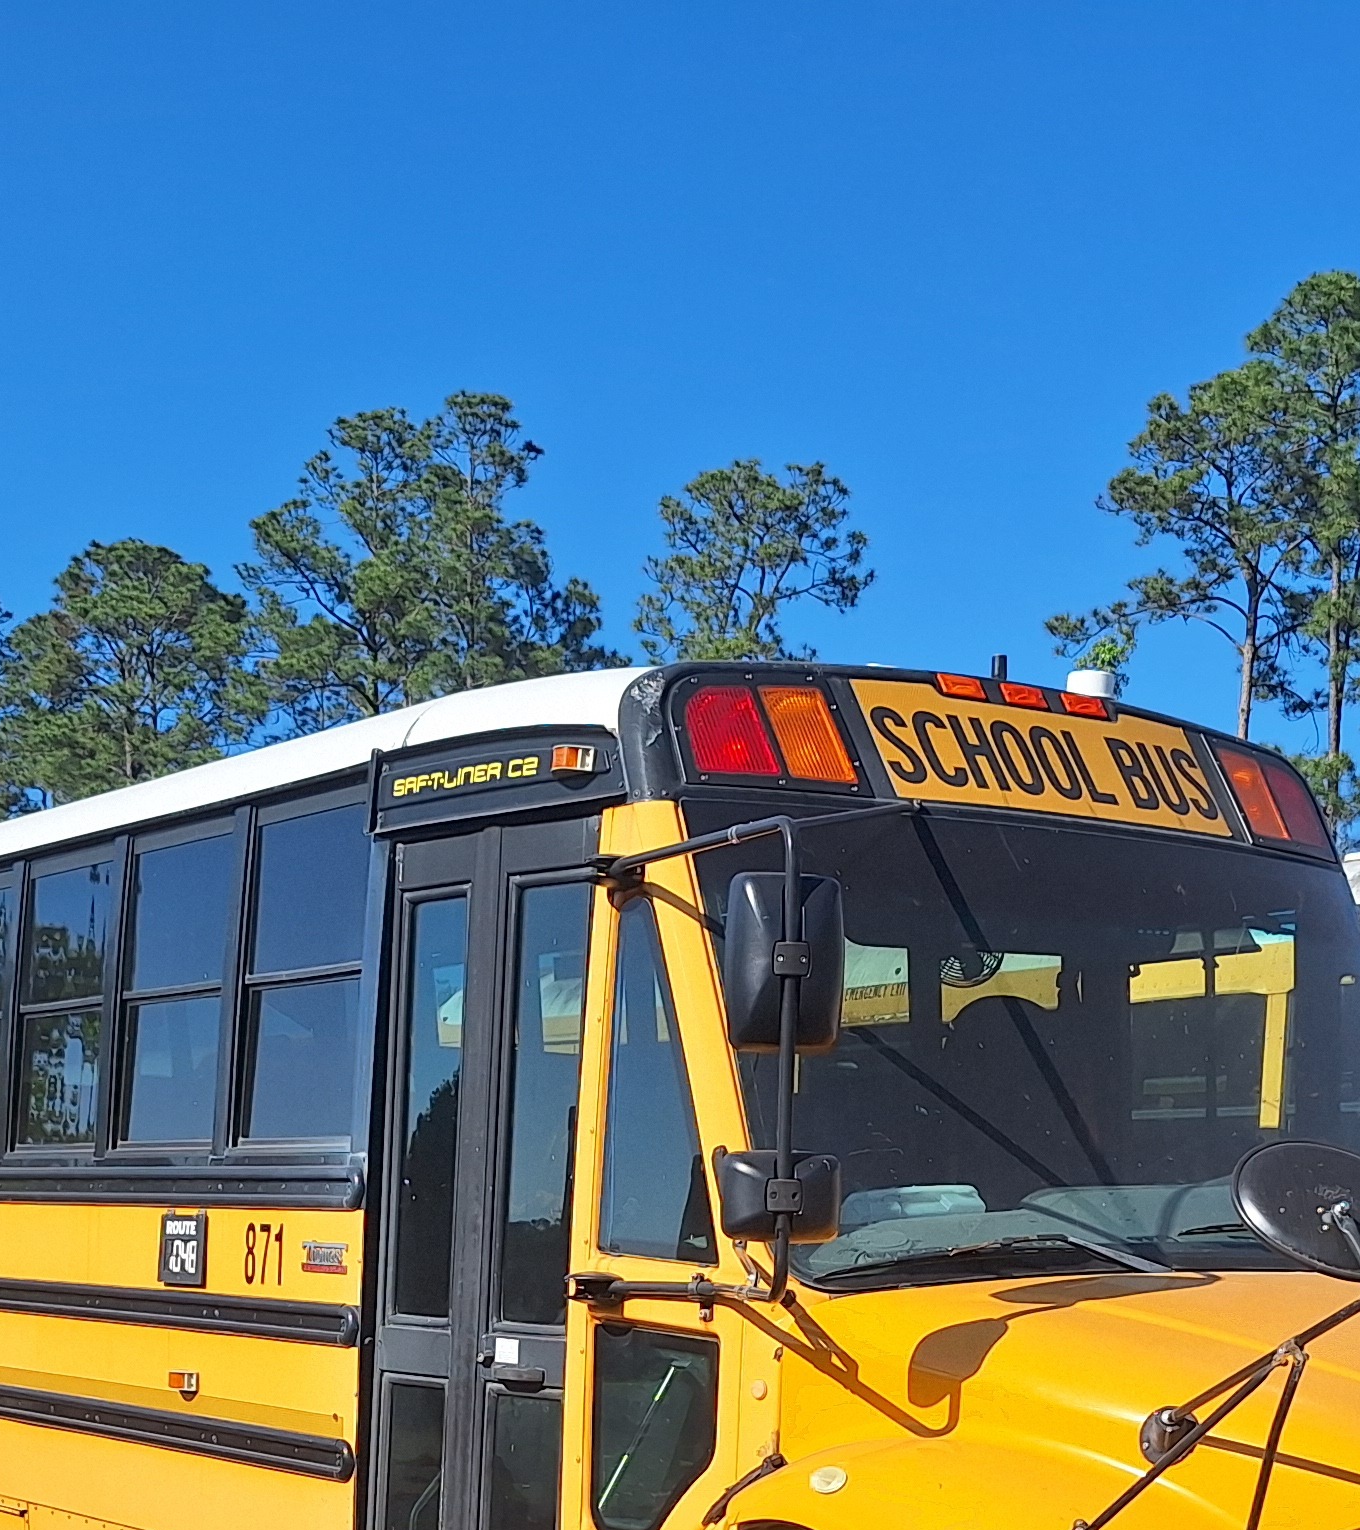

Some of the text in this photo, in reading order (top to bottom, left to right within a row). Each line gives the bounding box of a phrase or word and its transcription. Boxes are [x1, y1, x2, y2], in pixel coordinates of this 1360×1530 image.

[507, 756, 538, 778] C2
[870, 706, 1219, 821] SCHOOL BUS
[165, 1220, 197, 1235] ROUTE
[244, 1222, 284, 1286] 871
